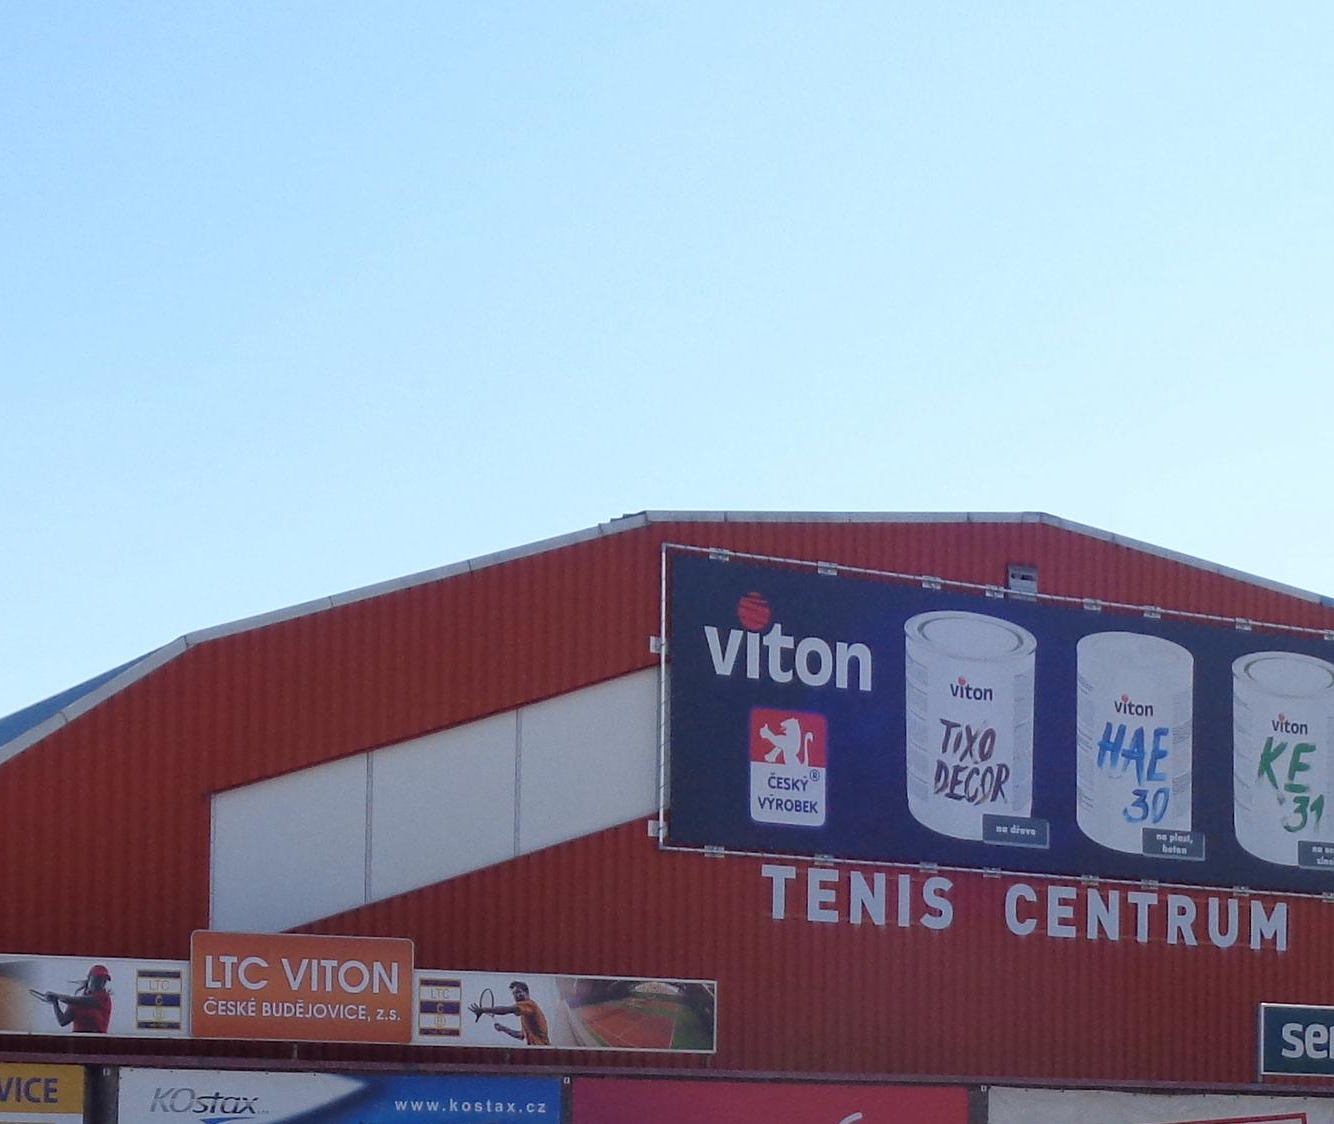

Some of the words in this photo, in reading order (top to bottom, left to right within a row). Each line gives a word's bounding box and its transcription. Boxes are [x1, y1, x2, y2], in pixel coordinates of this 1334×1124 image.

[704, 592, 872, 691] viton
[950, 676, 993, 701] viton
[1114, 694, 1154, 717] viton
[1271, 713, 1308, 735] viton
[1097, 722, 1169, 786] HAE
[1257, 736, 1317, 793] KE
[767, 772, 809, 791] ČESKÝ
[934, 759, 1010, 806] DECOR
[758, 794, 818, 814] VÝROBEK
[1123, 787, 1170, 824] 30
[1283, 794, 1325, 832] 31
[761, 865, 954, 930] TENIS
[1004, 883, 1288, 952] CENTRUM
[203, 955, 268, 990] LTC
[280, 956, 400, 994] VITON
[203, 997, 256, 1016] ČESKÉ
[262, 1000, 370, 1022] BUDĚJOVICE,
[376, 1008, 401, 1021] z.s.
[395, 1098, 547, 1114] www.kostax.cz
